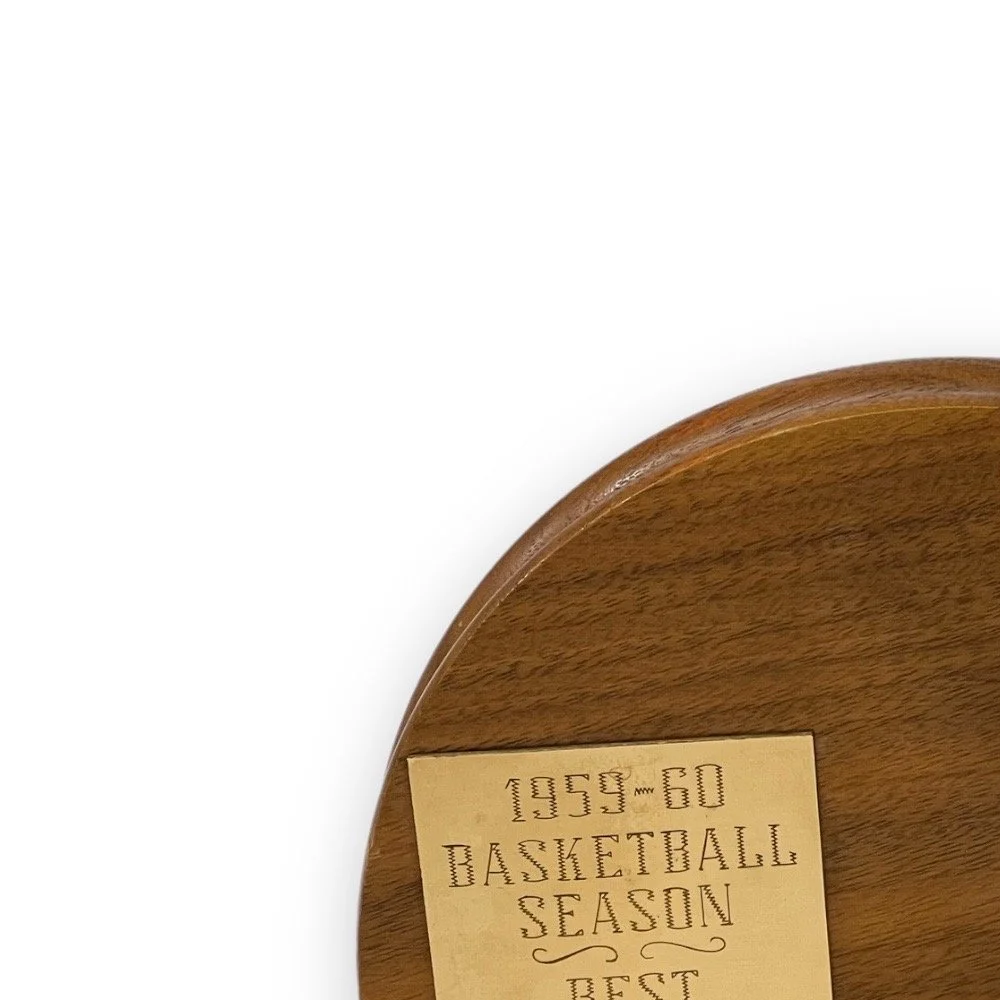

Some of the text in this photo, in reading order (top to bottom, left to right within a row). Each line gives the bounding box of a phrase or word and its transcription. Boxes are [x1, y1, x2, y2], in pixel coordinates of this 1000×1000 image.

[505, 763, 725, 822] 1959-60
[442, 824, 797, 887] BASKETBALL
[518, 883, 733, 938] SEASON
